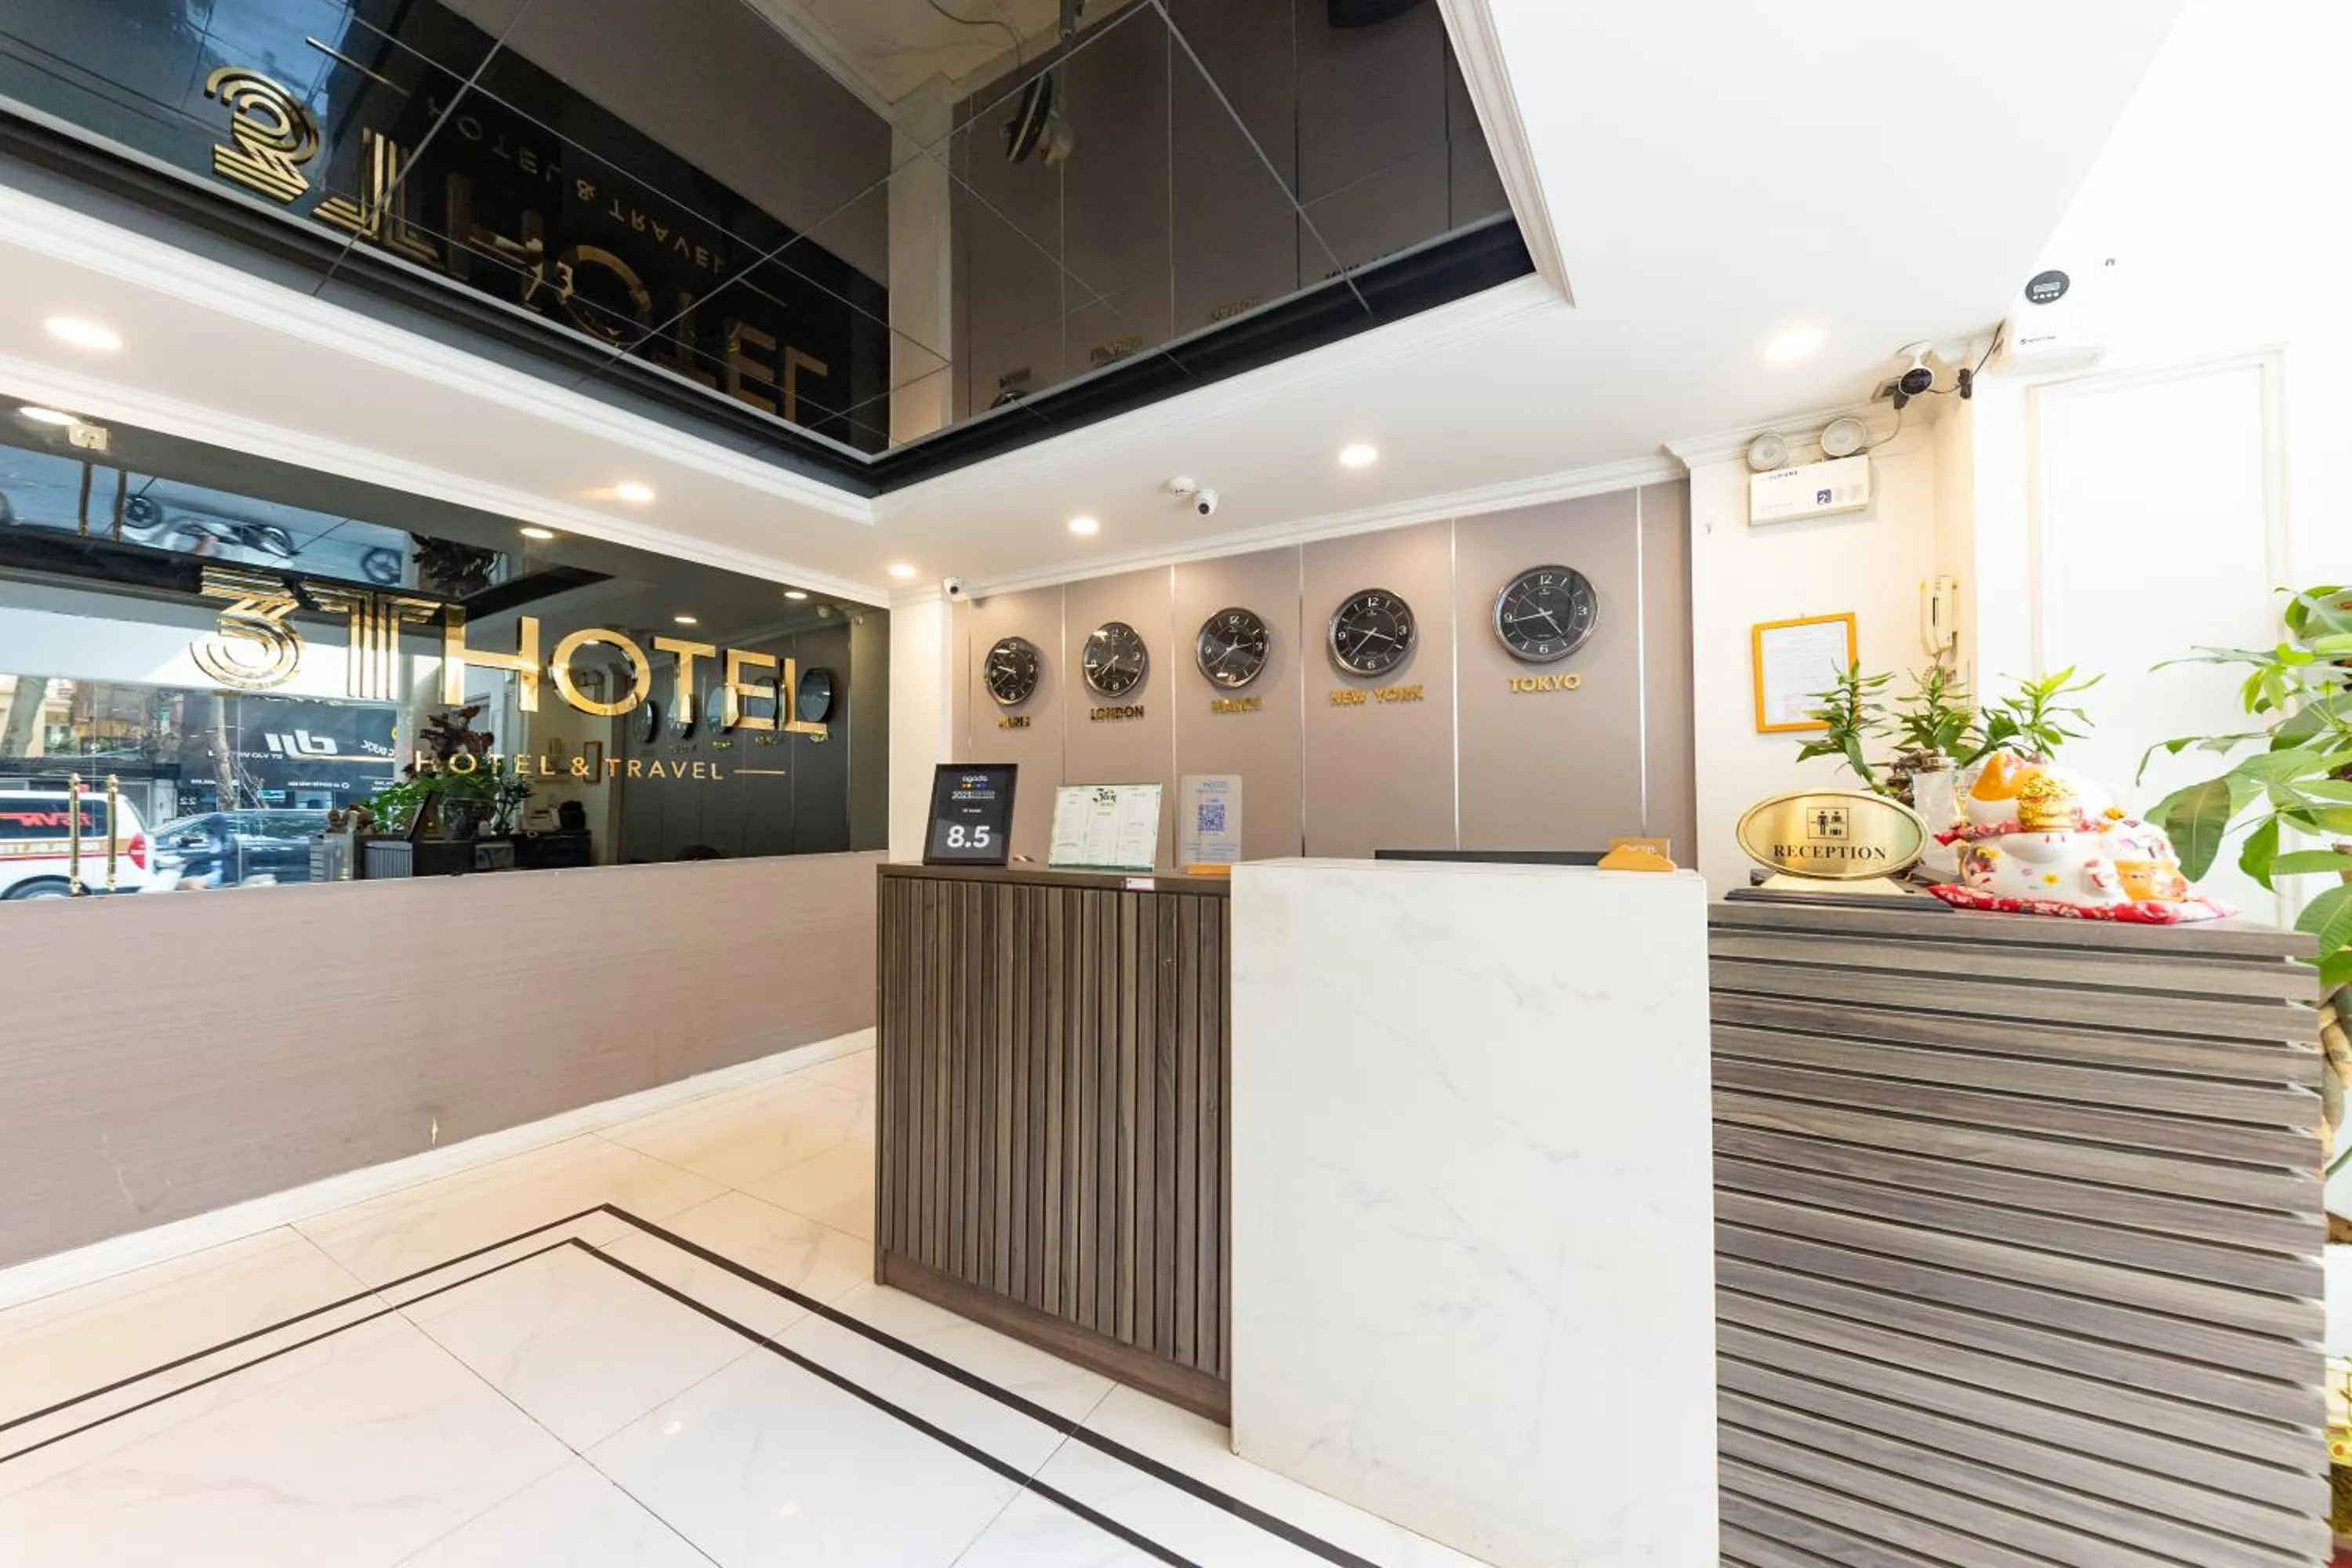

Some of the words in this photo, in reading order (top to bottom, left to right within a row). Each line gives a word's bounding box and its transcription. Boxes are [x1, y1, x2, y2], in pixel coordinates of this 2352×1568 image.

[441, 603, 829, 735] HOTEL
[1508, 672, 1581, 693] TOKYO
[1330, 689, 1367, 704] NEW
[415, 750, 555, 776] HOTEL
[570, 756, 590, 777] &
[604, 757, 724, 780] TRAVEL
[946, 824, 991, 848] 8.5
[1773, 844, 1886, 860] RECEPTION
